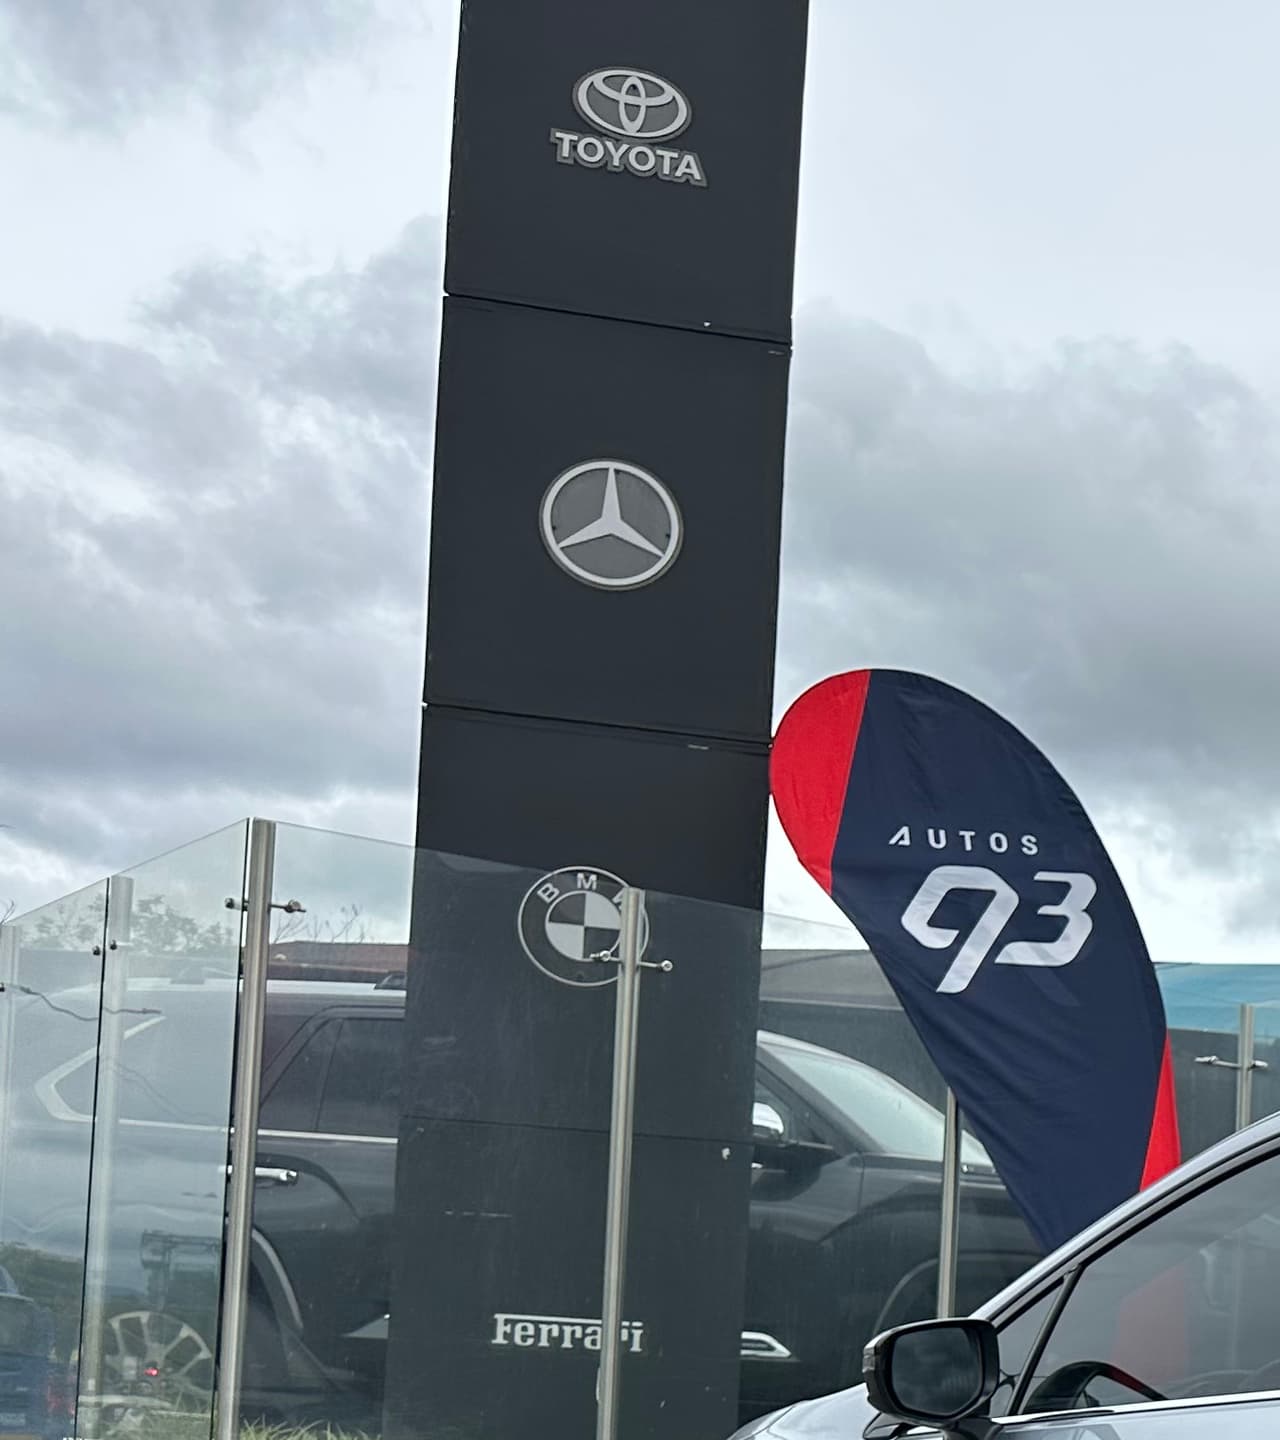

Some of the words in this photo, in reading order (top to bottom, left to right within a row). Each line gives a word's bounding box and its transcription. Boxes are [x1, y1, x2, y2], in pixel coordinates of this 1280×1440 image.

[555, 131, 702, 181] TOYOTA
[889, 826, 1038, 855] AUTOS
[901, 865, 1096, 993] 93
